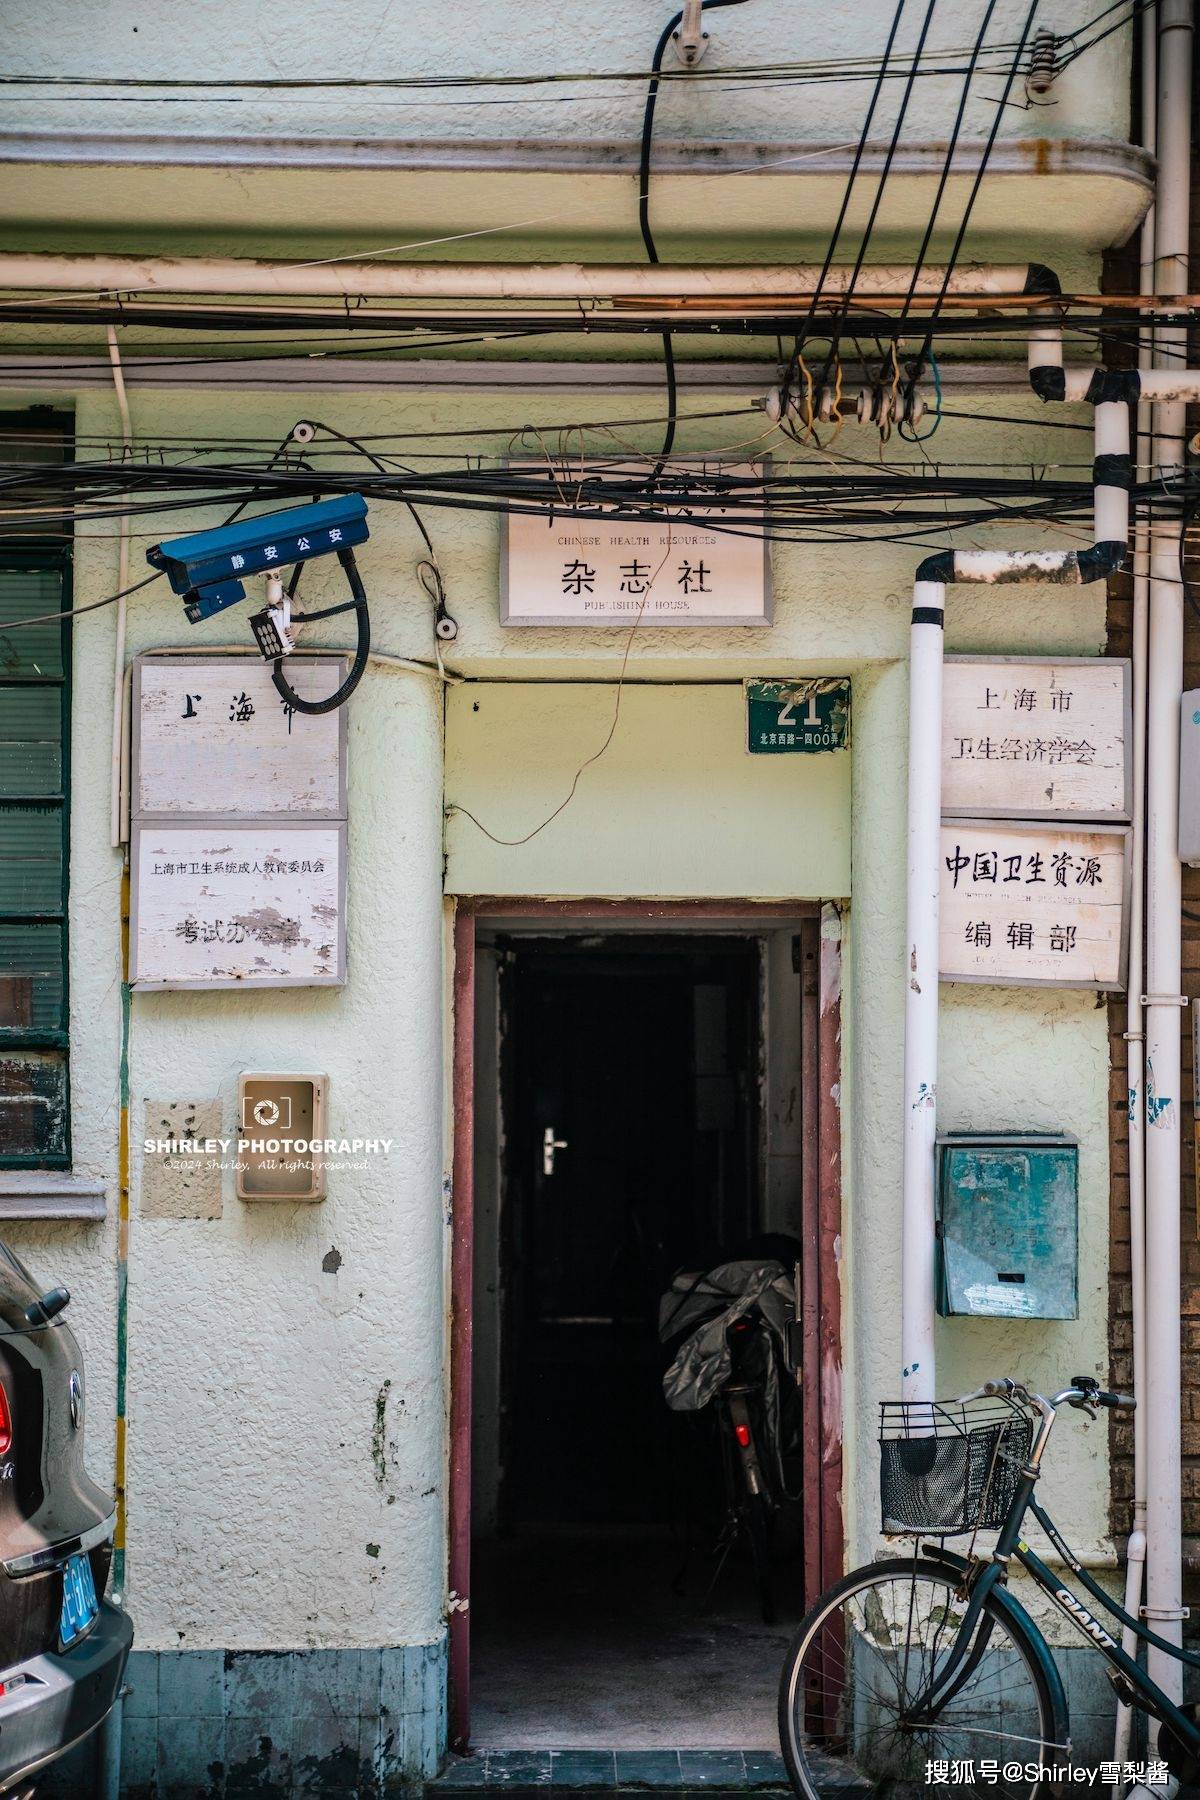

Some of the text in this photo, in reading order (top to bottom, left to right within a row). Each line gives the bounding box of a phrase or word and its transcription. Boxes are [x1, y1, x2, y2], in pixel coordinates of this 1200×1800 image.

[231, 528, 343, 570] 静安公安
[557, 536, 601, 546] CHINESE
[609, 536, 650, 546] HEALTH
[561, 558, 713, 595] 杂志社
[584, 600, 651, 610] PUBISHING
[181, 685, 301, 735] 上海市
[976, 687, 1074, 714] 上海市
[951, 737, 1097, 764] 卫生经济学会
[150, 860, 325, 876] 上海市卫生系统成人教育委员会
[945, 845, 1103, 889] 中国卫生资源
[964, 920, 1077, 954] 编辑部
[1055, 1589, 1118, 1649] GIANT
